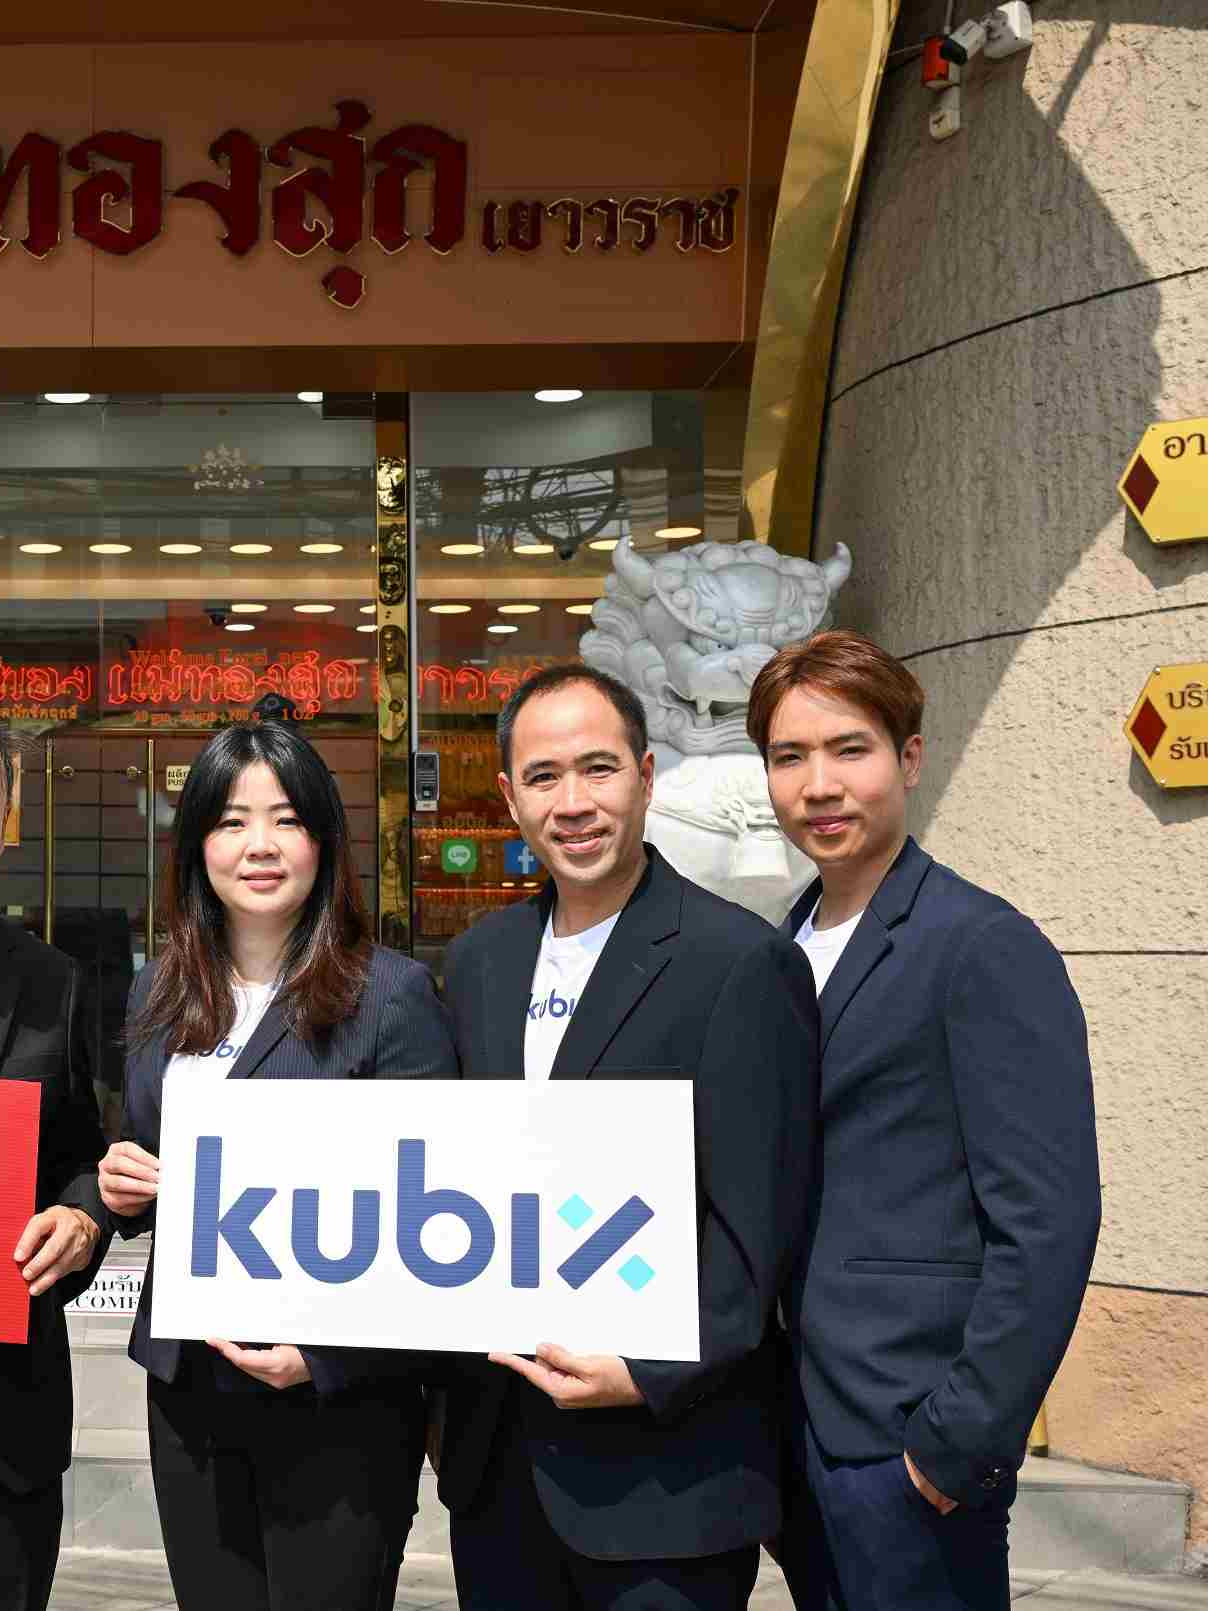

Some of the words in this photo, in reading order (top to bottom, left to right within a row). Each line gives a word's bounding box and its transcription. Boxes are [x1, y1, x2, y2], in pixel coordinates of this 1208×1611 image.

[482, 187, 740, 254] เยาวราช
[107, 649, 357, 714] แม่ทองสุก
[1166, 682, 1208, 710] บริ
[190, 1135, 657, 1292] kubix
